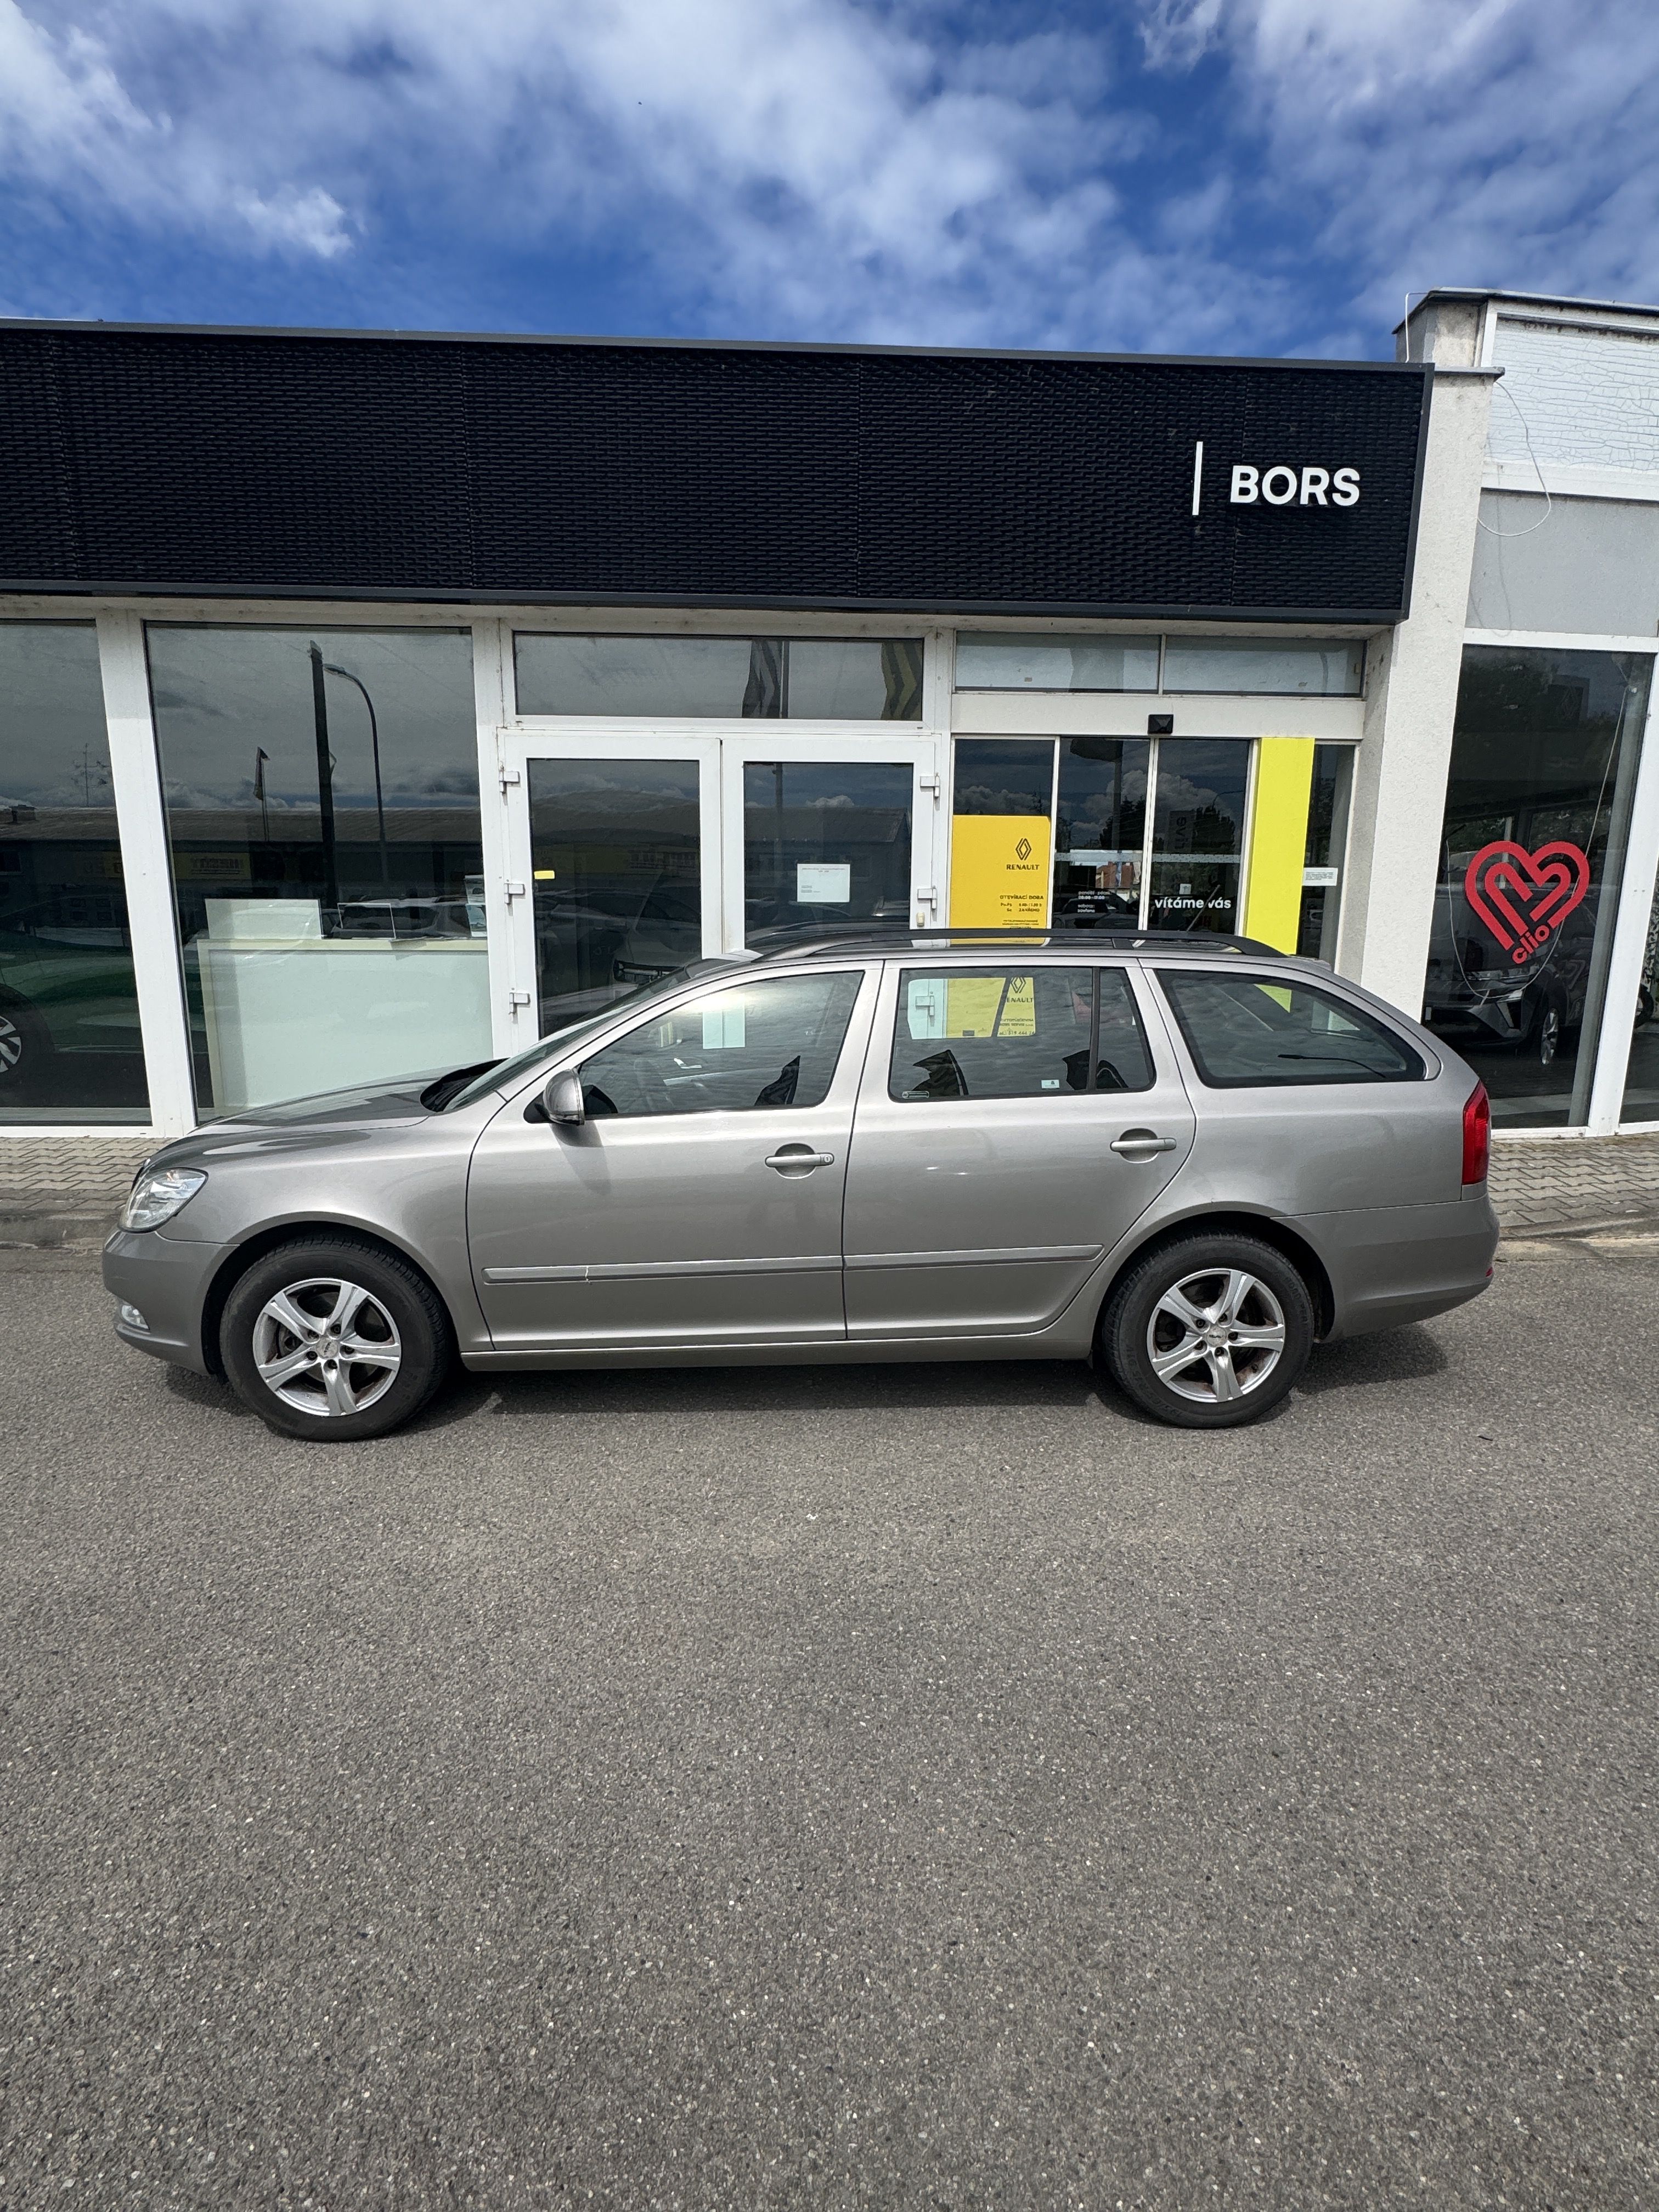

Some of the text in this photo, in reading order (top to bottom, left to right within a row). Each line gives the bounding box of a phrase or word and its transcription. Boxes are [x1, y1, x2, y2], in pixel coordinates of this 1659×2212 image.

[1230, 465, 1360, 506] BORS
[1155, 896, 1231, 909] vítáme vás
[1512, 924, 1550, 964] clio
